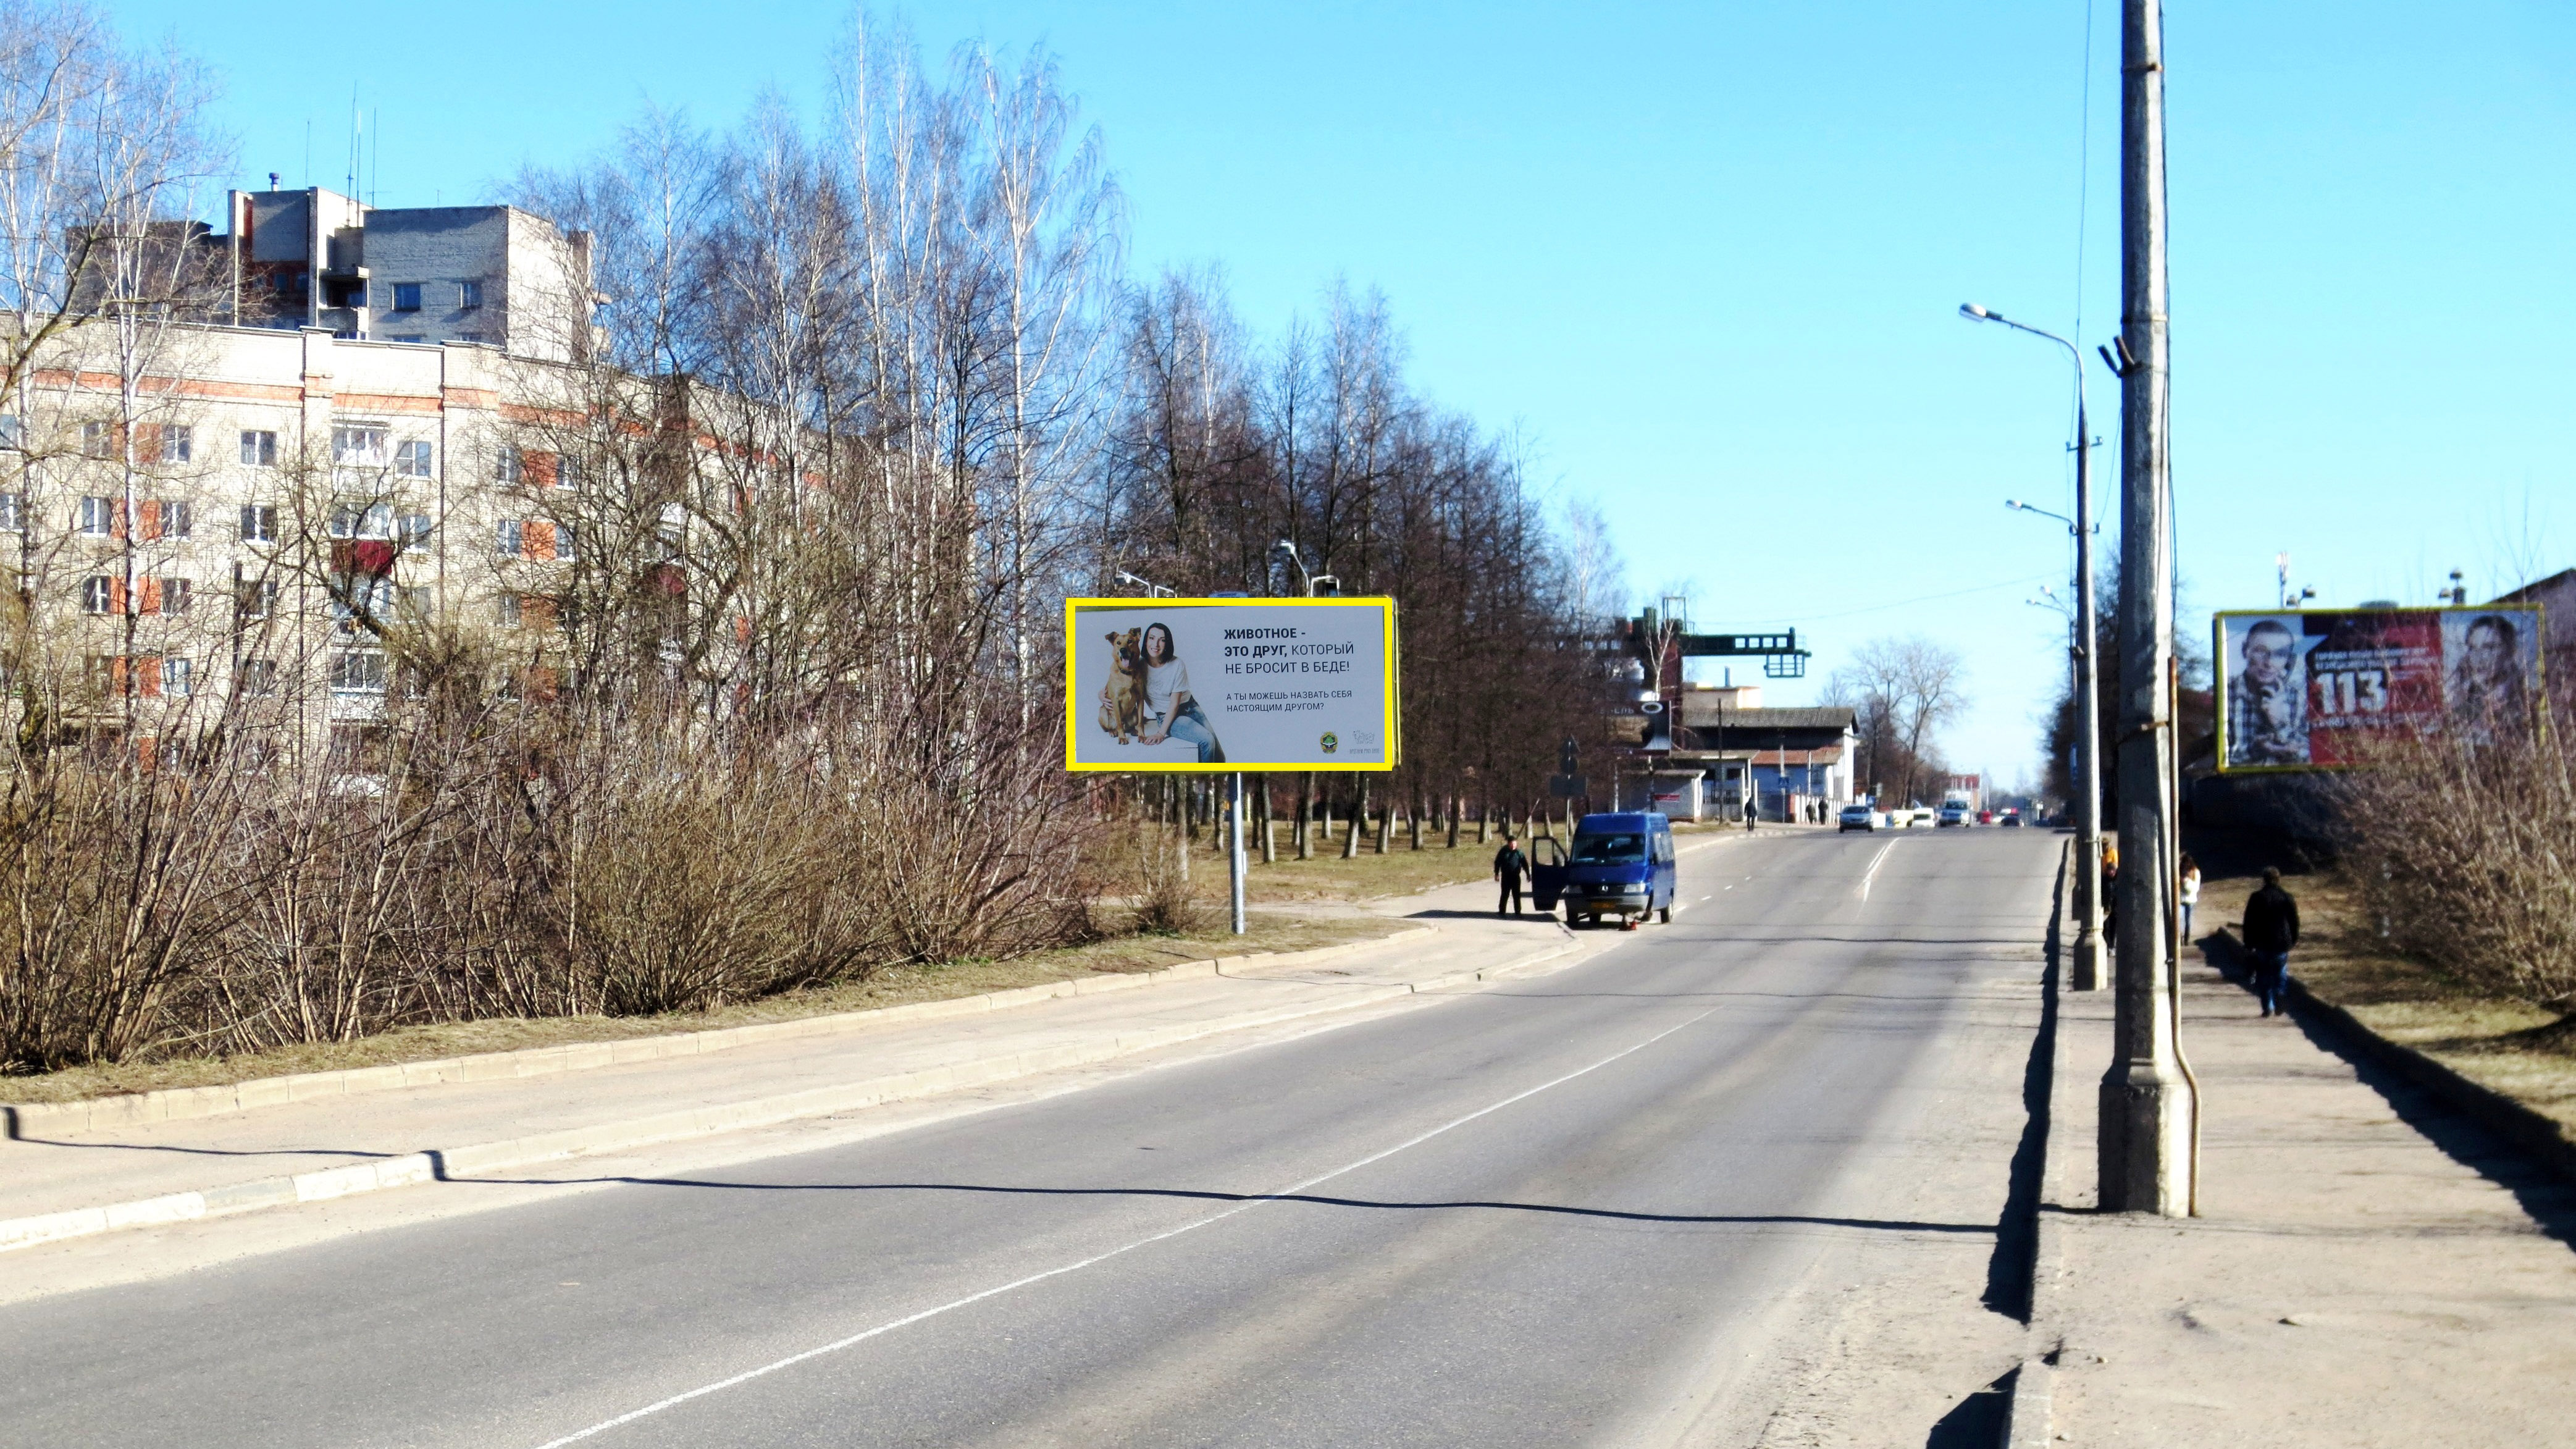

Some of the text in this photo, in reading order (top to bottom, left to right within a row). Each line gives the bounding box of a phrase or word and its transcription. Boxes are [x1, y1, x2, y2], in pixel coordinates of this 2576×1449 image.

[1224, 628, 1297, 639] ЖИВОТНОЕ
[1224, 641, 1354, 658] ЭТО ДРУГ, КОТОРЫЙ
[1225, 661, 1349, 674] НЕ БРОСИТ В БЕДЕ!
[1249, 692, 1288, 700] МОЖЕШЬ
[1290, 691, 1329, 699] НАЗВАТЬ
[1331, 690, 1352, 698] СЕБЯ
[2316, 671, 2388, 715] 113
[1227, 703, 1324, 713] НАСТОЯЩИМ ДРУГОМ?
